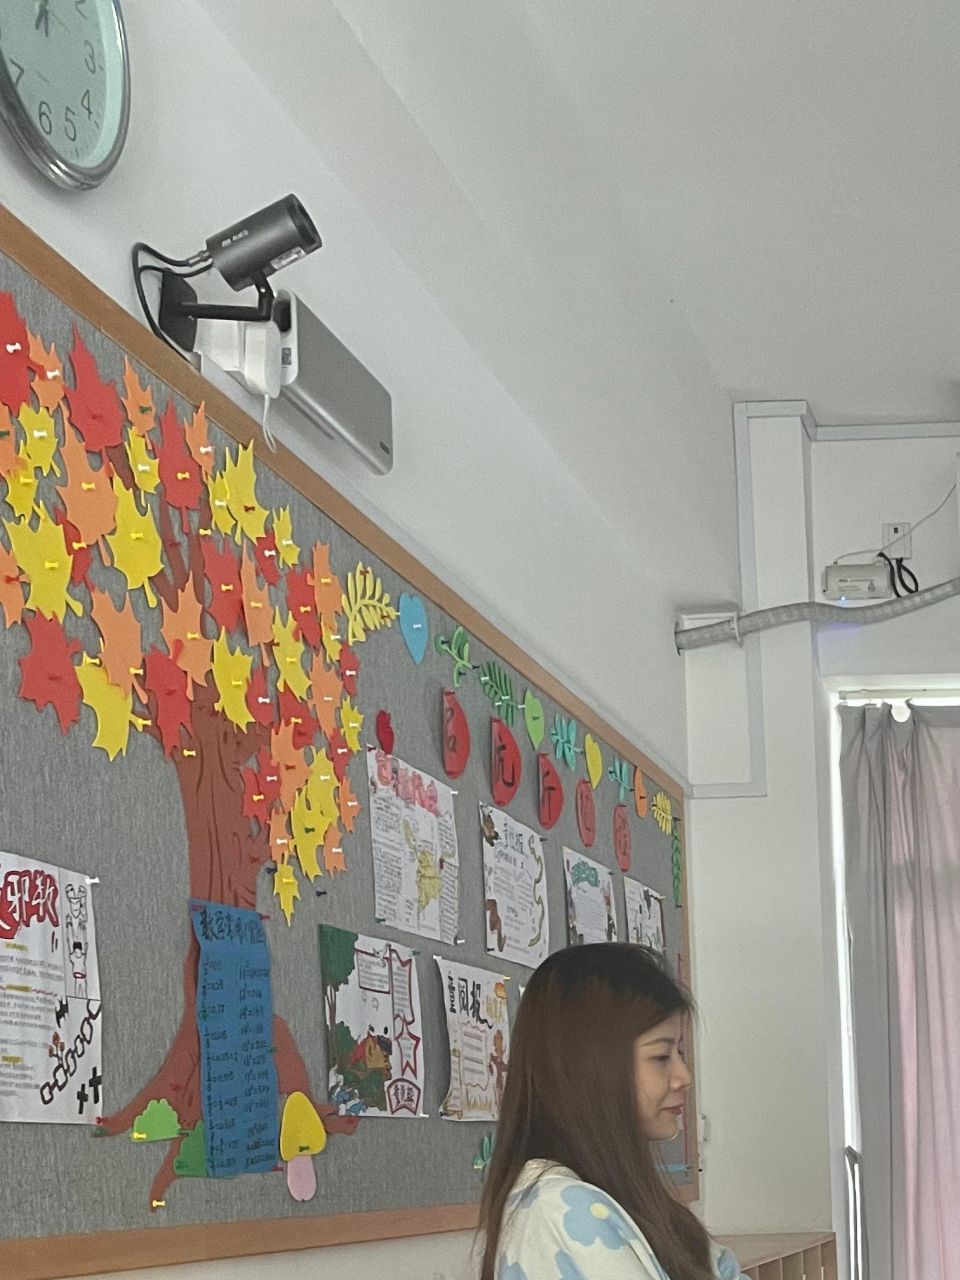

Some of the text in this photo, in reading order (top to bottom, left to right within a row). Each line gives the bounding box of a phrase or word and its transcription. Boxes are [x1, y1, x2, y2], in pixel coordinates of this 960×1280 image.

[9, 58, 24, 88] 7
[84, 39, 97, 74] 3
[38, 100, 53, 135] 6
[80, 88, 94, 120] 4
[63, 105, 77, 141] 5
[0, 873, 57, 930] 邪教
